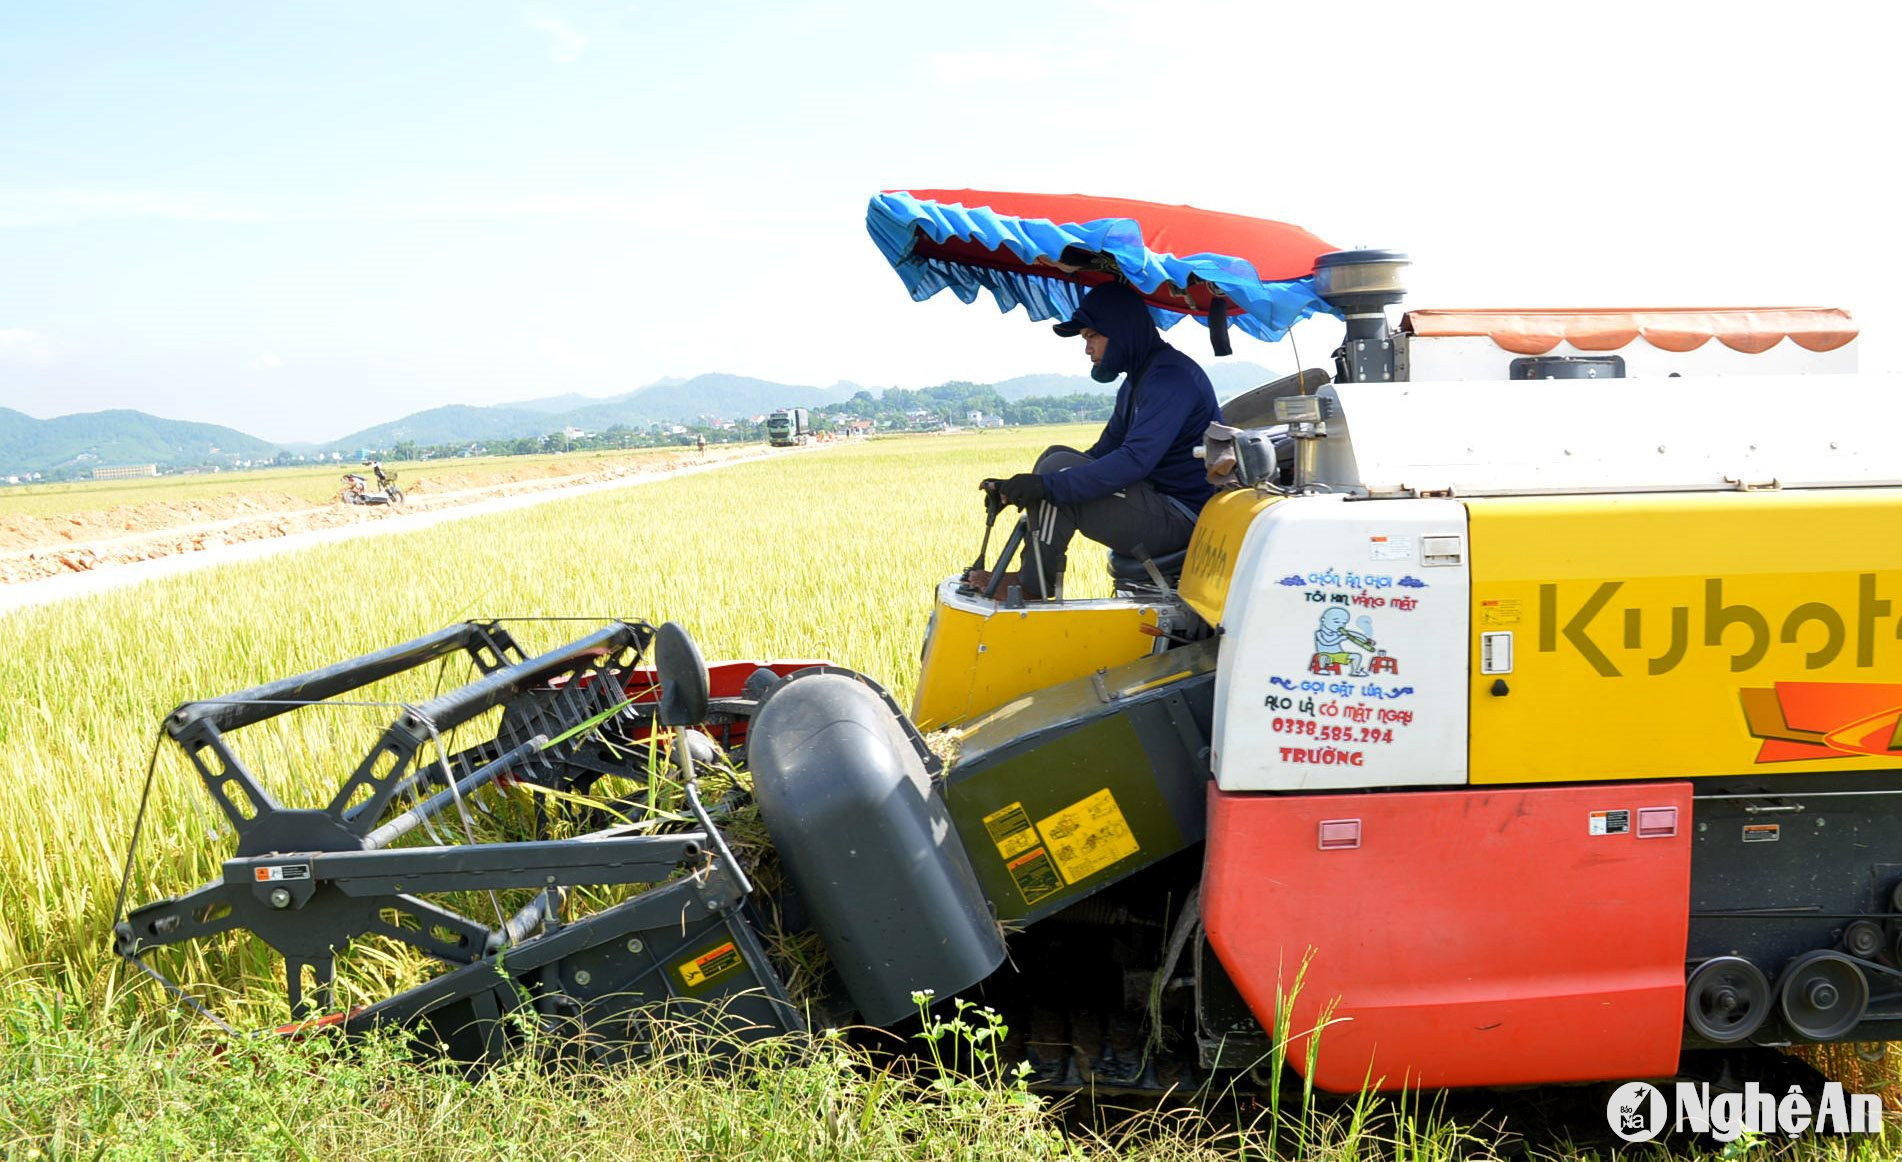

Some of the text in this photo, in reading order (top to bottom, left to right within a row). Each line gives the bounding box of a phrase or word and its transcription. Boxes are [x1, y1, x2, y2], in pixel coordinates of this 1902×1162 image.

[1304, 590, 1326, 603] TÔI
[1351, 588, 1386, 609] VẮNG
[1539, 572, 1902, 678] Kubot
[1300, 680, 1325, 695] GỌI
[1264, 694, 1414, 726] ALO LÀ CÓ MẶT NGAY
[1272, 717, 1394, 744] 0338.585.294
[1279, 745, 1364, 767] TRƯỜNG
